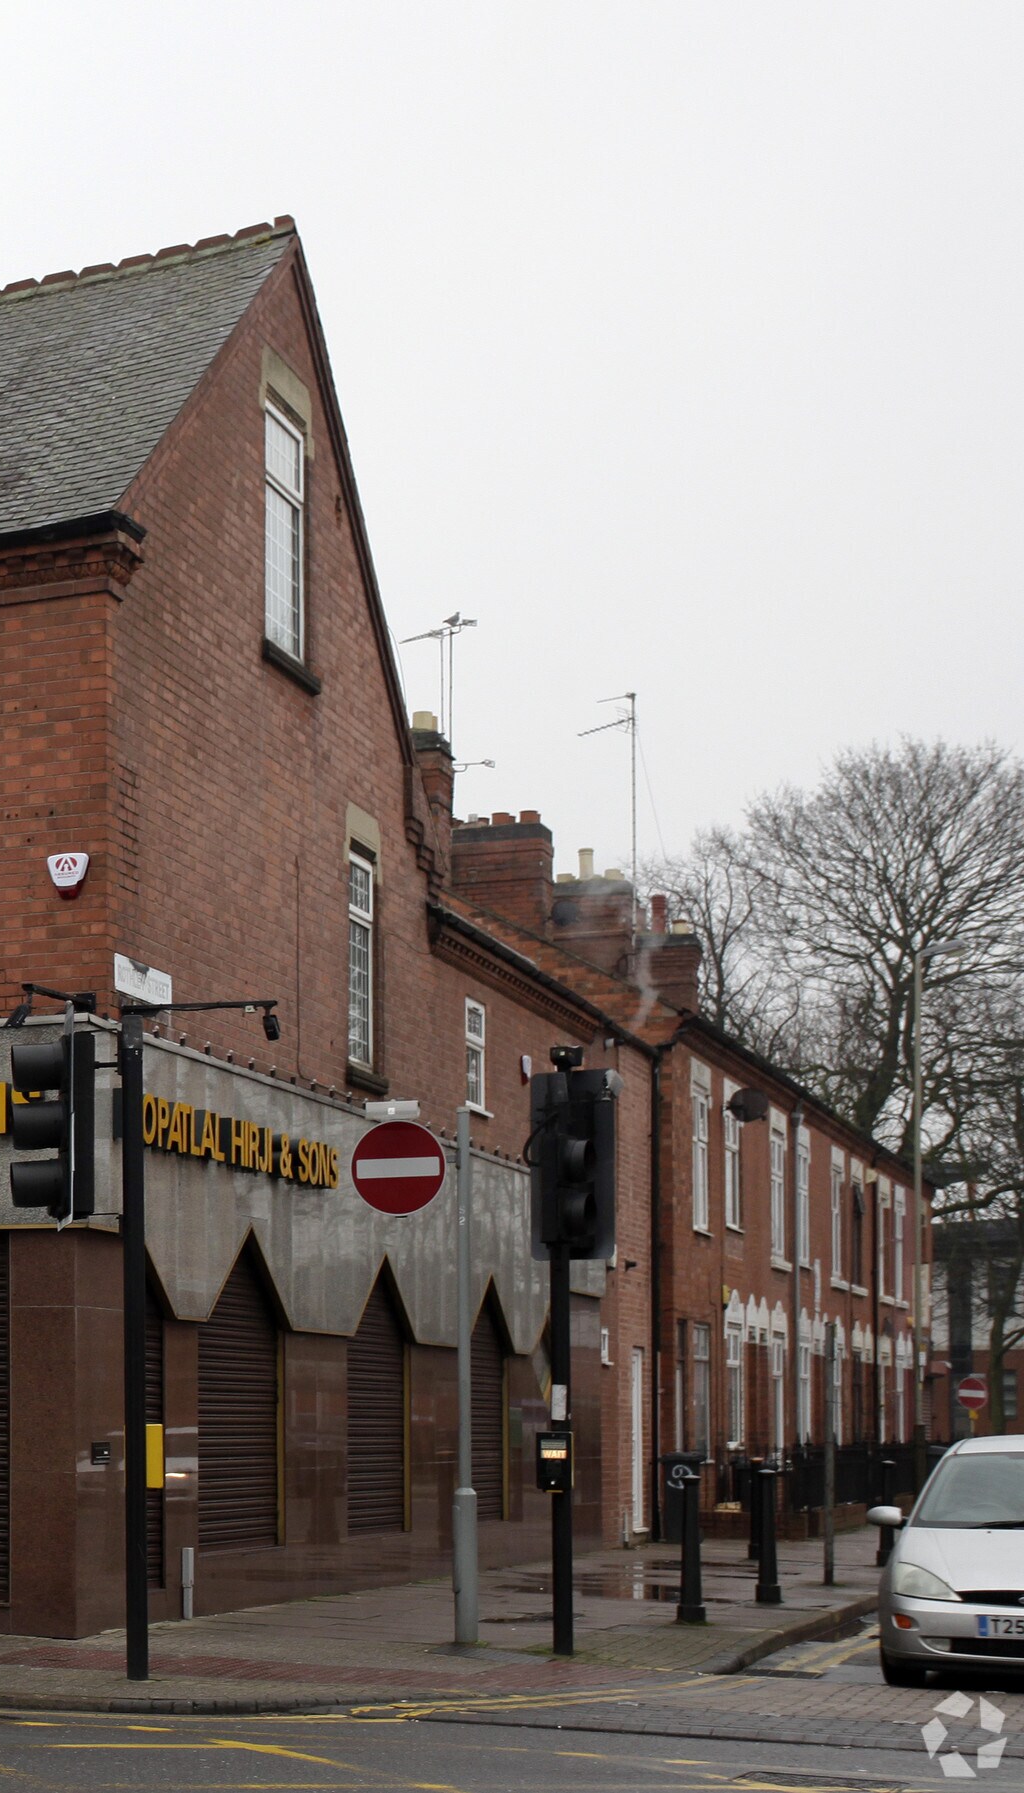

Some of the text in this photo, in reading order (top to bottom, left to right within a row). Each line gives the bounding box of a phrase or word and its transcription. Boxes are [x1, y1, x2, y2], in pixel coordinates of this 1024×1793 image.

[142, 1093, 339, 1189] OPATLAL HIRJI & SONS
[542, 1450, 567, 1459] WAIT
